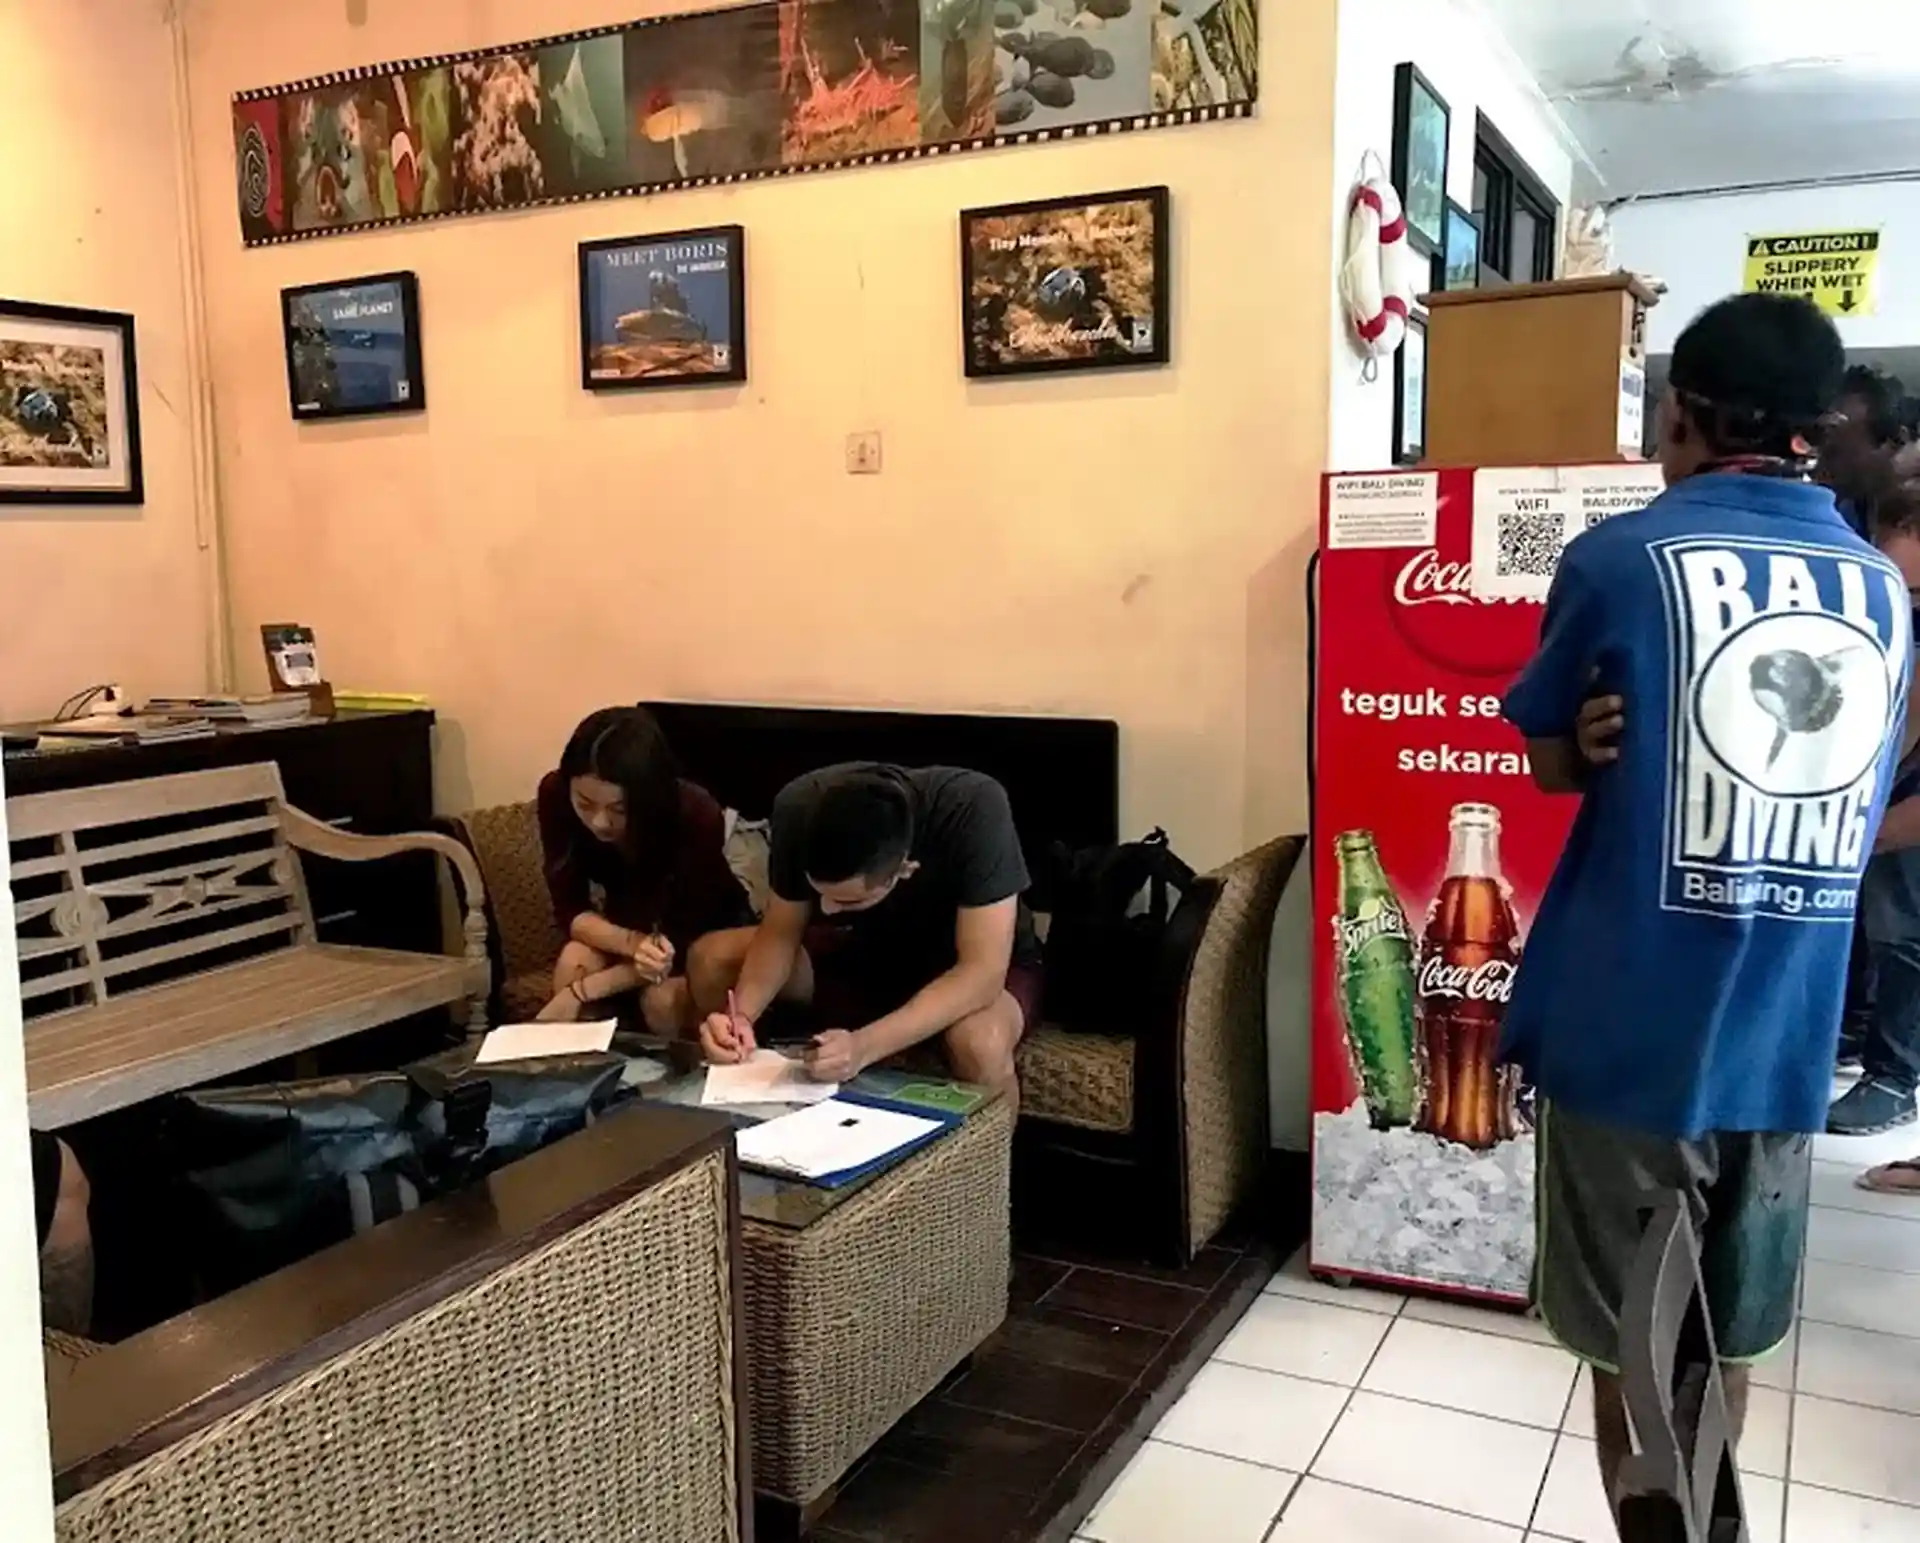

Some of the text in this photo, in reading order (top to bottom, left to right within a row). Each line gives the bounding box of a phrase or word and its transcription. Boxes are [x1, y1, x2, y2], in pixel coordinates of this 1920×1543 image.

[606, 249, 659, 267] MEET
[665, 241, 728, 262] BORIS
[1764, 256, 1861, 276] SLIPPERY
[1755, 273, 1866, 292] WHEN WET
[1361, 480, 1385, 489] BALI
[1388, 478, 1425, 488] DIVING
[1514, 498, 1549, 511] WIFI
[1394, 548, 1476, 606] Coca
[1341, 688, 1510, 725] teguk se
[1684, 765, 1877, 868] DIVING
[1344, 909, 1401, 956] Sprite
[1418, 955, 1519, 1003] Coca-Col
